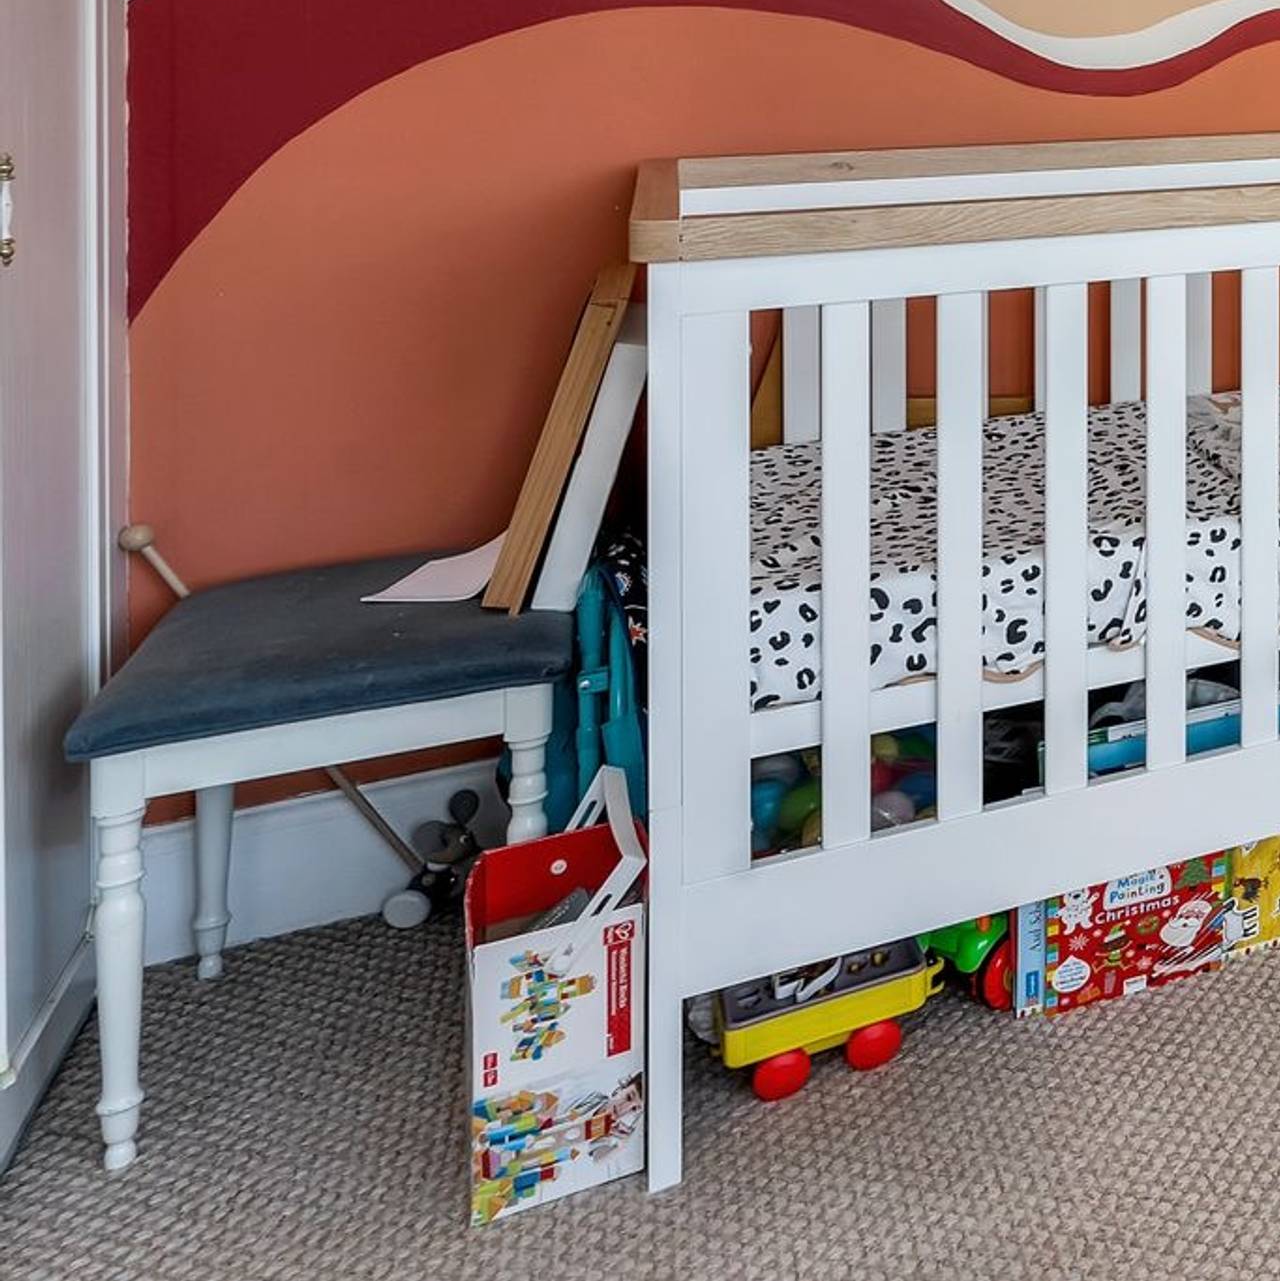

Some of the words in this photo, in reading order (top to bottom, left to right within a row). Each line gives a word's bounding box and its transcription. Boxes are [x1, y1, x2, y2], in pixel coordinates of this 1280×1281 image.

[1117, 871, 1157, 889] Magic
[1109, 882, 1166, 904] Painting
[1095, 895, 1181, 925] Christmas
